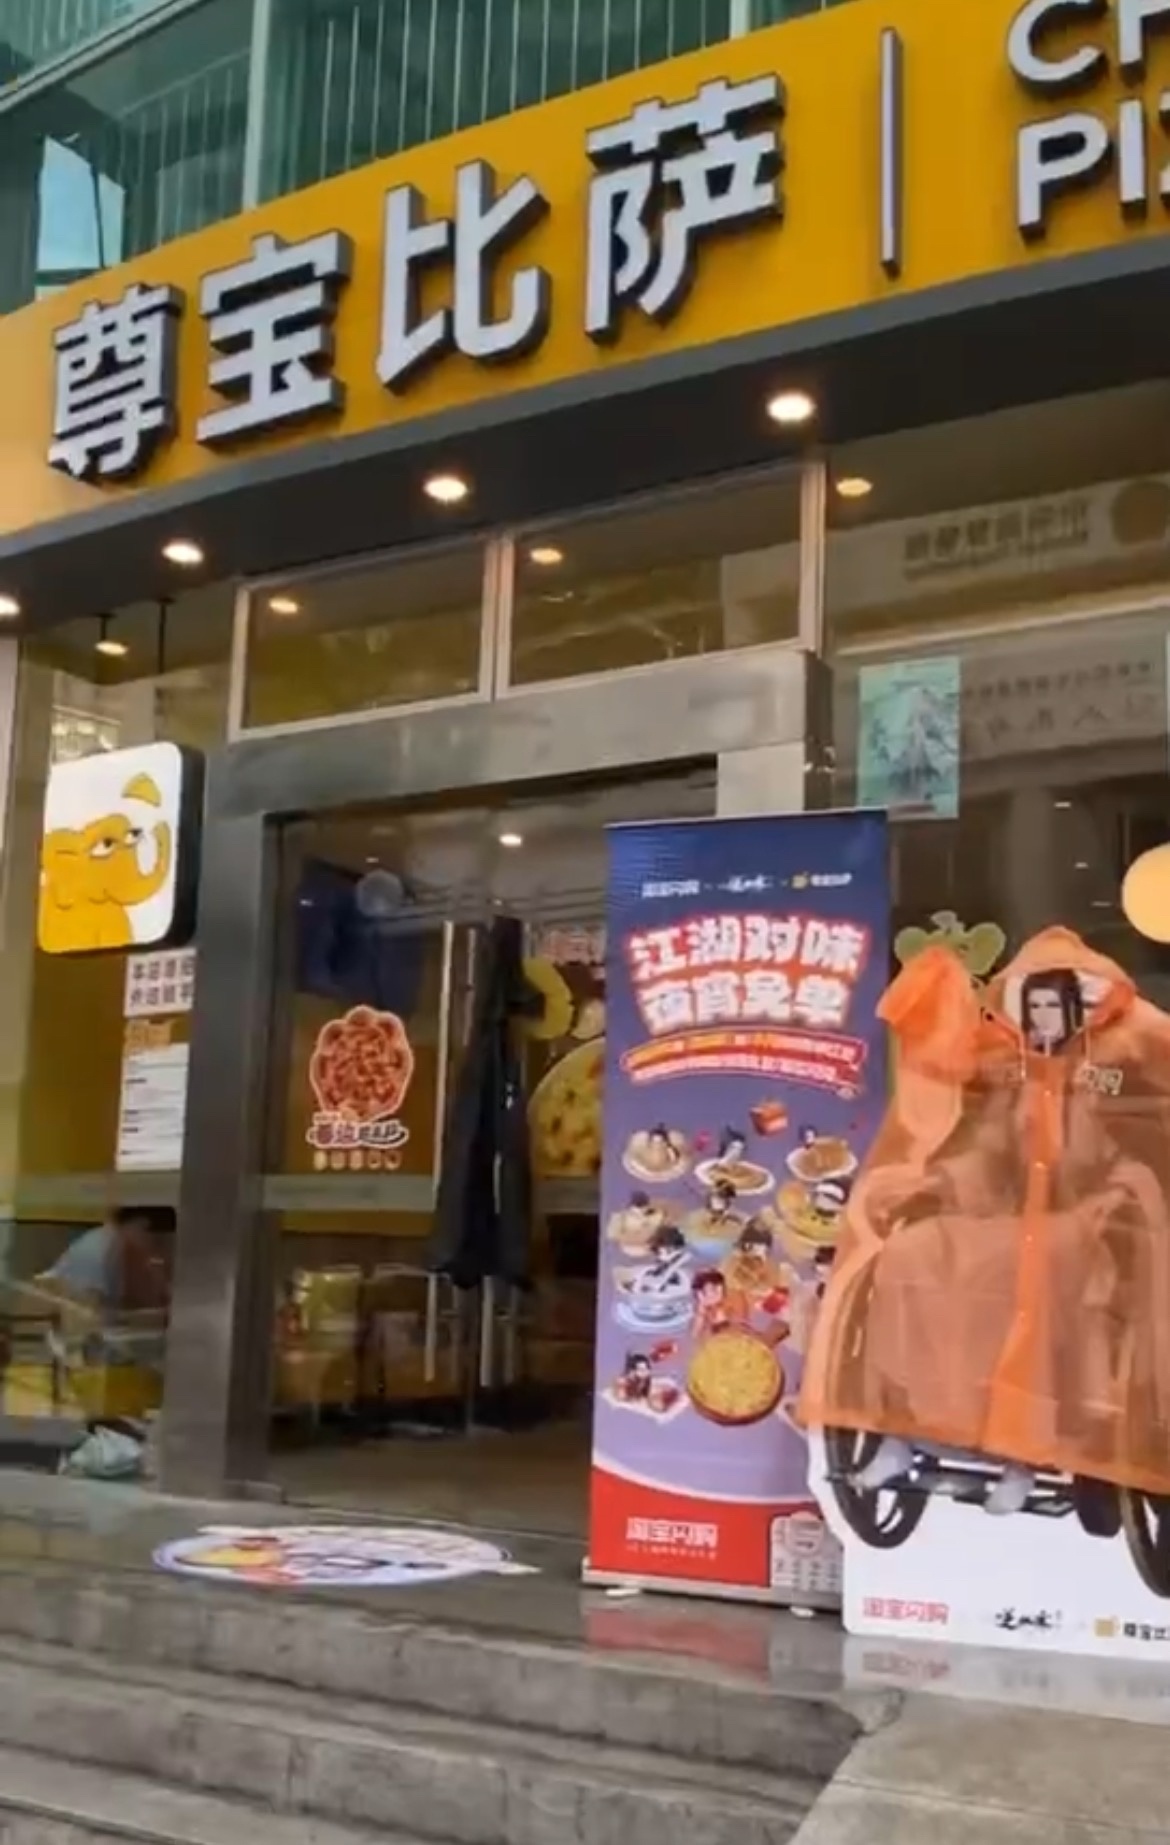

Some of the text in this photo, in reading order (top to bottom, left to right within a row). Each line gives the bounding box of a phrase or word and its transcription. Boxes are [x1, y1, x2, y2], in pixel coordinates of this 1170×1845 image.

[1018, 90, 1170, 238] PI
[46, 72, 785, 482] 尊宝比萨
[629, 914, 866, 983] 江湖对味
[625, 1517, 718, 1548] 淘宝闪购
[863, 1597, 949, 1625] 淘宝闪购
